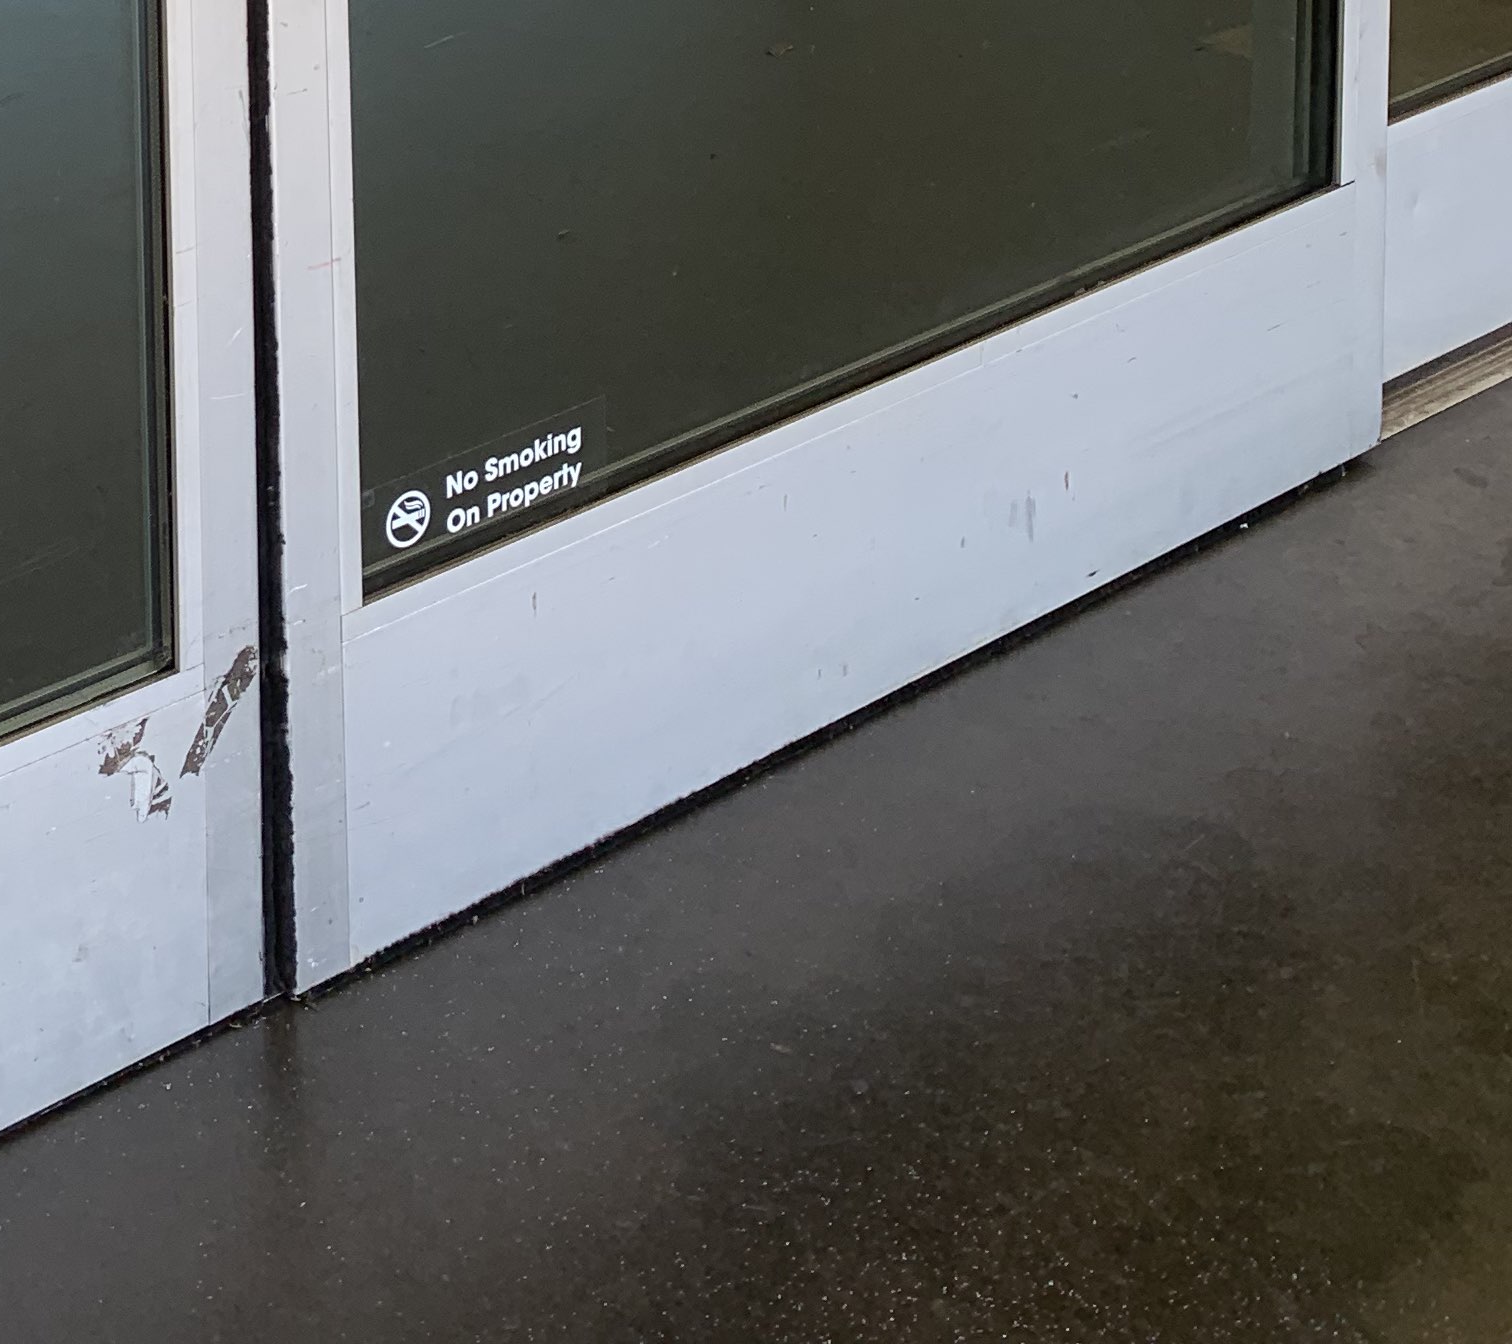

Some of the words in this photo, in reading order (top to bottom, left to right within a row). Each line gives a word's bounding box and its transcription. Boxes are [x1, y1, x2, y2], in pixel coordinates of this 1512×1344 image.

[445, 469, 479, 499] No
[484, 425, 583, 482] Smoking
[446, 505, 481, 534] On
[487, 462, 583, 518] Property
